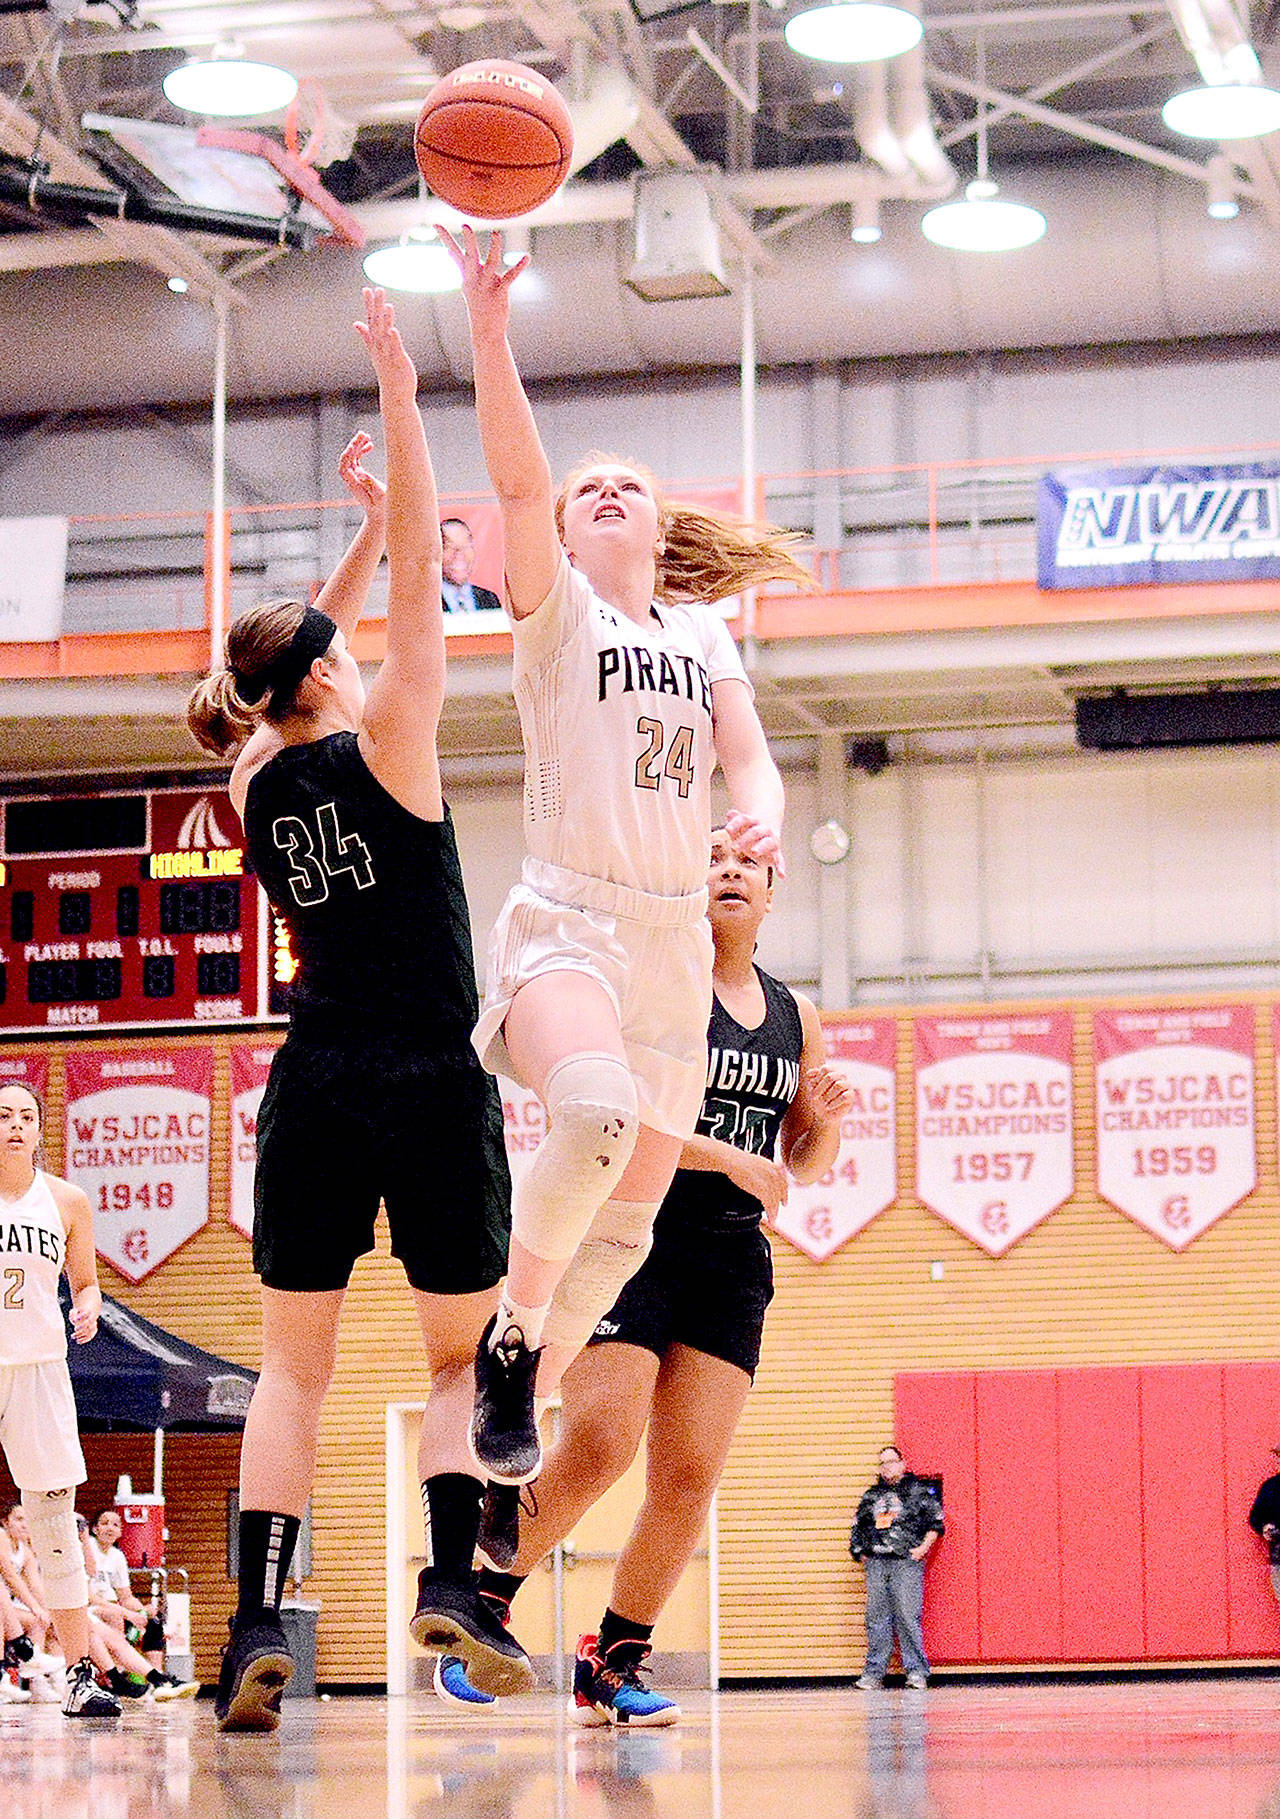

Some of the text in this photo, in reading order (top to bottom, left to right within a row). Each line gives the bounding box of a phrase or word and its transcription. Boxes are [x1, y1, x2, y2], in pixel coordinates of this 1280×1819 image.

[635, 716, 695, 799] 24
[150, 848, 243, 879] HIGHLINE
[272, 802, 376, 907] 34
[24, 941, 80, 962] PLAYER
[46, 1005, 99, 1026] MATCH
[923, 1080, 1067, 1112] WSJCAC
[1103, 1074, 1248, 1106] WSJCAC
[72, 1112, 204, 1143] WSJCAC
[923, 1114, 1067, 1137] CHAMPIONS
[1103, 1107, 1249, 1132] CHAMPIONS
[72, 1143, 206, 1168] CHAMPIONS
[952, 1152, 1036, 1184] 1957
[1133, 1146, 1218, 1178] 1959
[98, 1182, 175, 1212] 1948
[4, 1268, 25, 1309] 2
